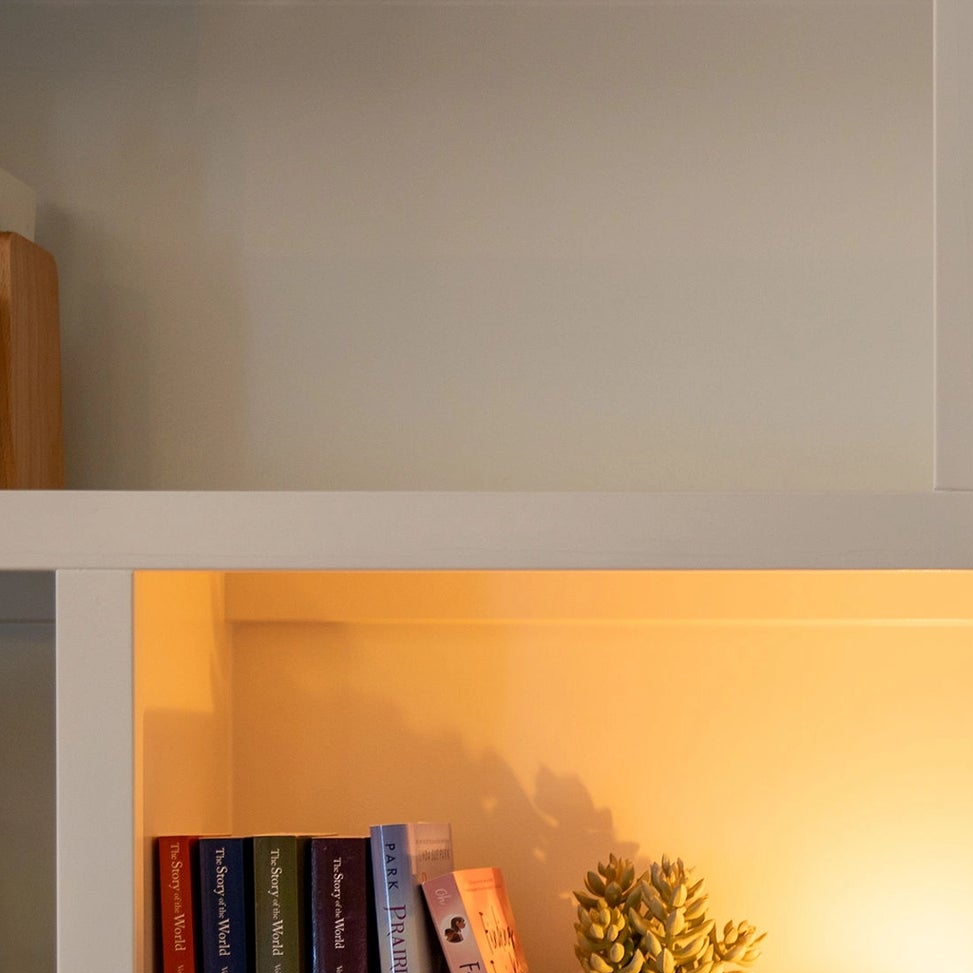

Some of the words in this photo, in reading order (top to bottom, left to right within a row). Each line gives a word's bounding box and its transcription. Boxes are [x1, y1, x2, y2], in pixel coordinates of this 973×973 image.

[170, 843, 180, 860] The
[215, 848, 225, 865] The
[270, 849, 280, 866] The
[333, 857, 341, 872] The
[385, 843, 399, 890] PARK
[169, 860, 183, 891] Story
[213, 866, 228, 896] Story
[268, 867, 282, 897] Story
[331, 873, 344, 899] Story
[174, 893, 181, 902] of
[218, 897, 225, 907] of
[273, 899, 280, 908] of
[335, 900, 341, 908] of
[435, 888, 450, 906] Oh
[174, 902, 182, 913] the
[218, 907, 226, 918] the
[174, 913, 186, 951] World
[218, 918, 230, 956] World
[272, 920, 284, 956] World
[334, 918, 345, 949] World
